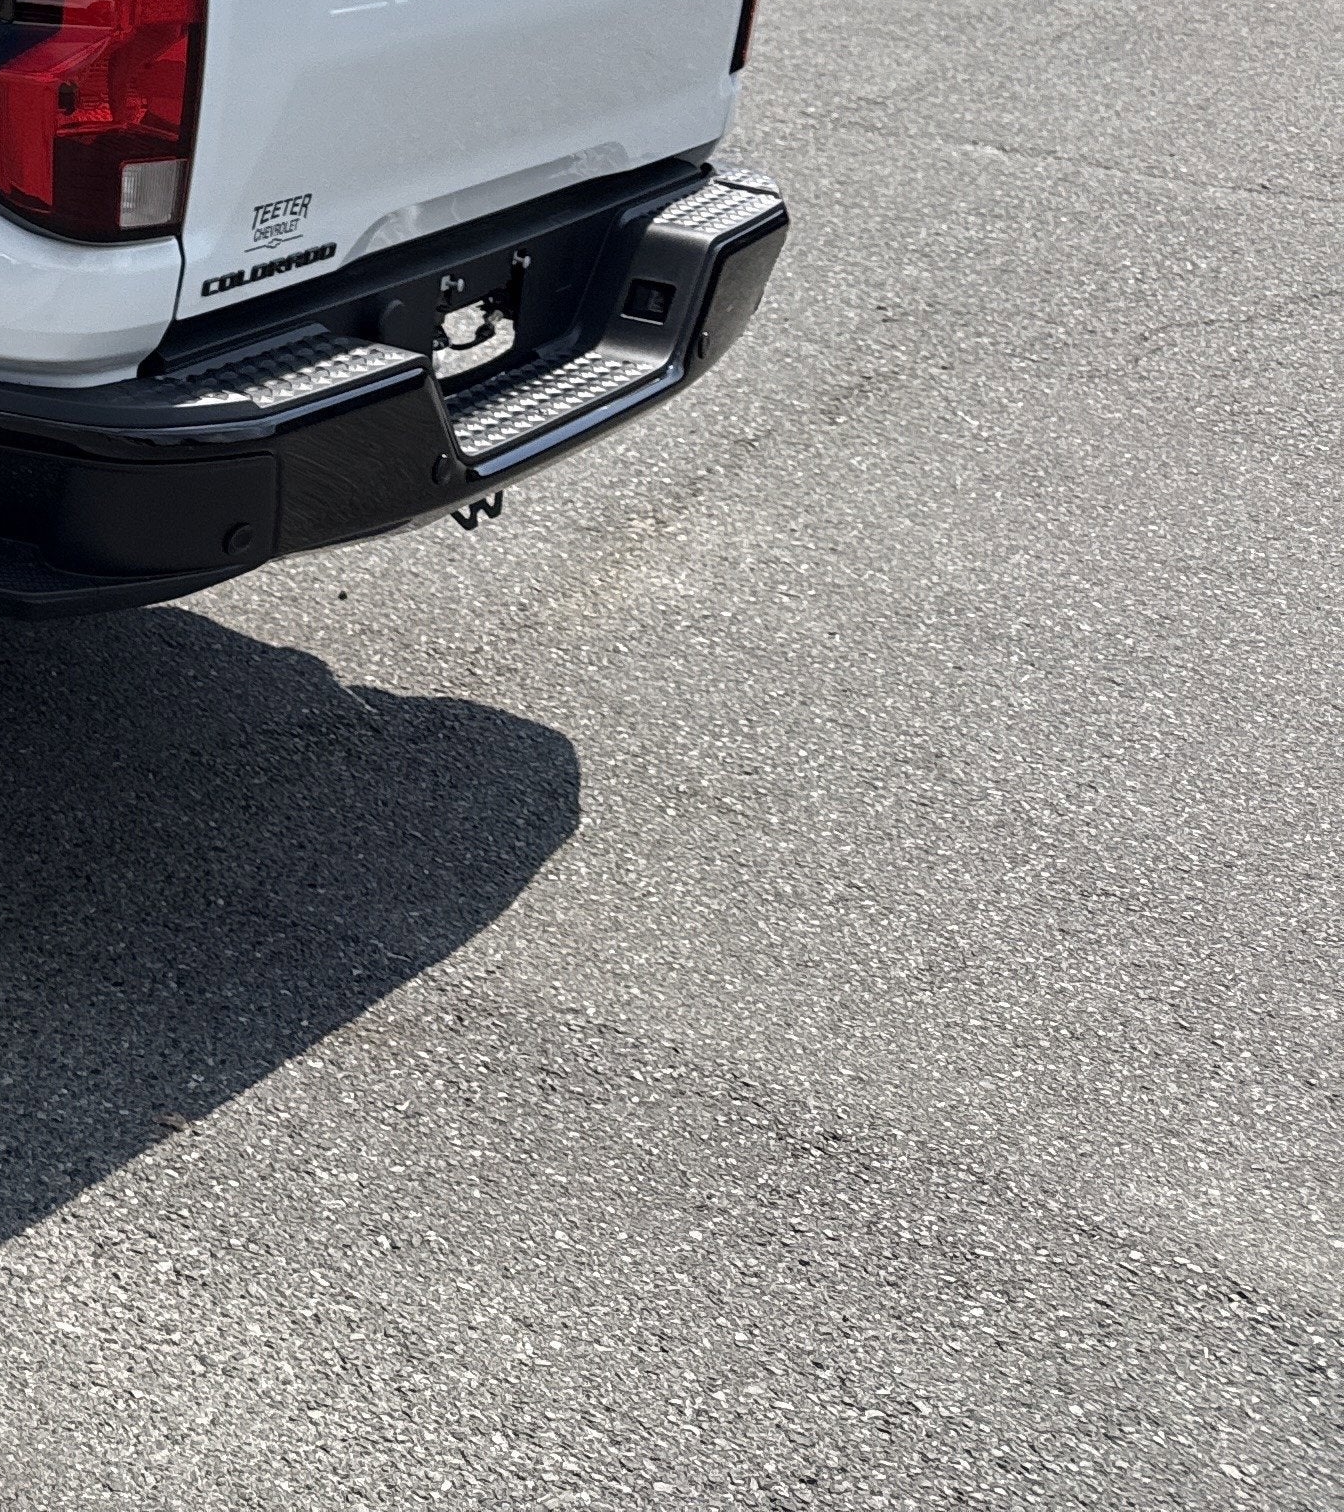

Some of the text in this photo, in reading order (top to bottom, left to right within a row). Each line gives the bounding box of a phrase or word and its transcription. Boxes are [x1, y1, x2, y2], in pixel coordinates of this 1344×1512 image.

[251, 193, 312, 230] TEETER
[253, 218, 300, 242] CHEVROLET
[200, 242, 337, 297] COLORADO
